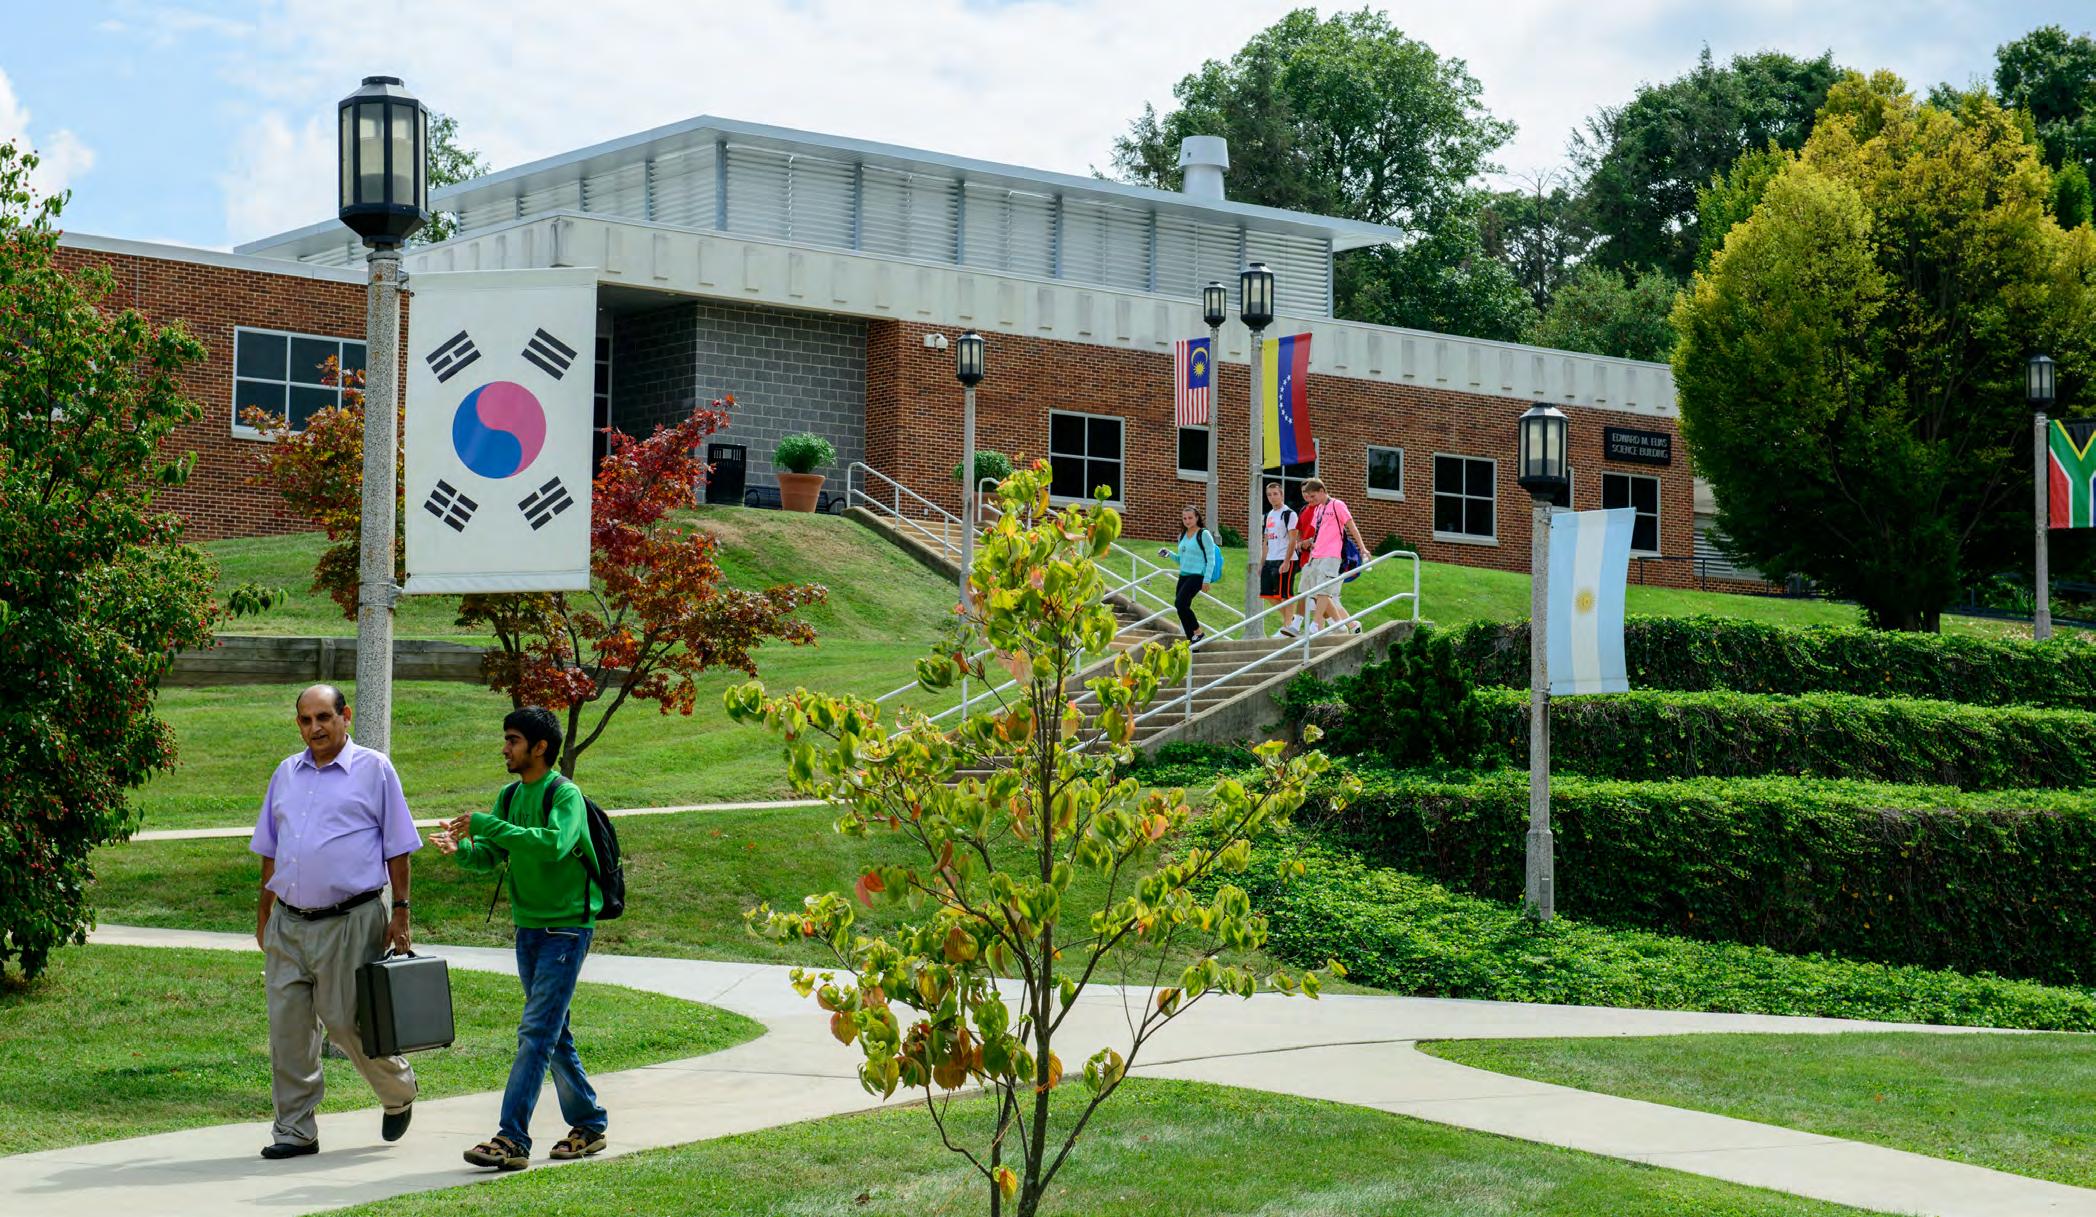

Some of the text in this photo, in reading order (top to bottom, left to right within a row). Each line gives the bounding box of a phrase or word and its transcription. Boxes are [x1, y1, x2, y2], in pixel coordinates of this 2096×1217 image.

[1612, 432, 1640, 445] EDWARD
[1611, 444, 1669, 459] SCIENCE BUILDING
